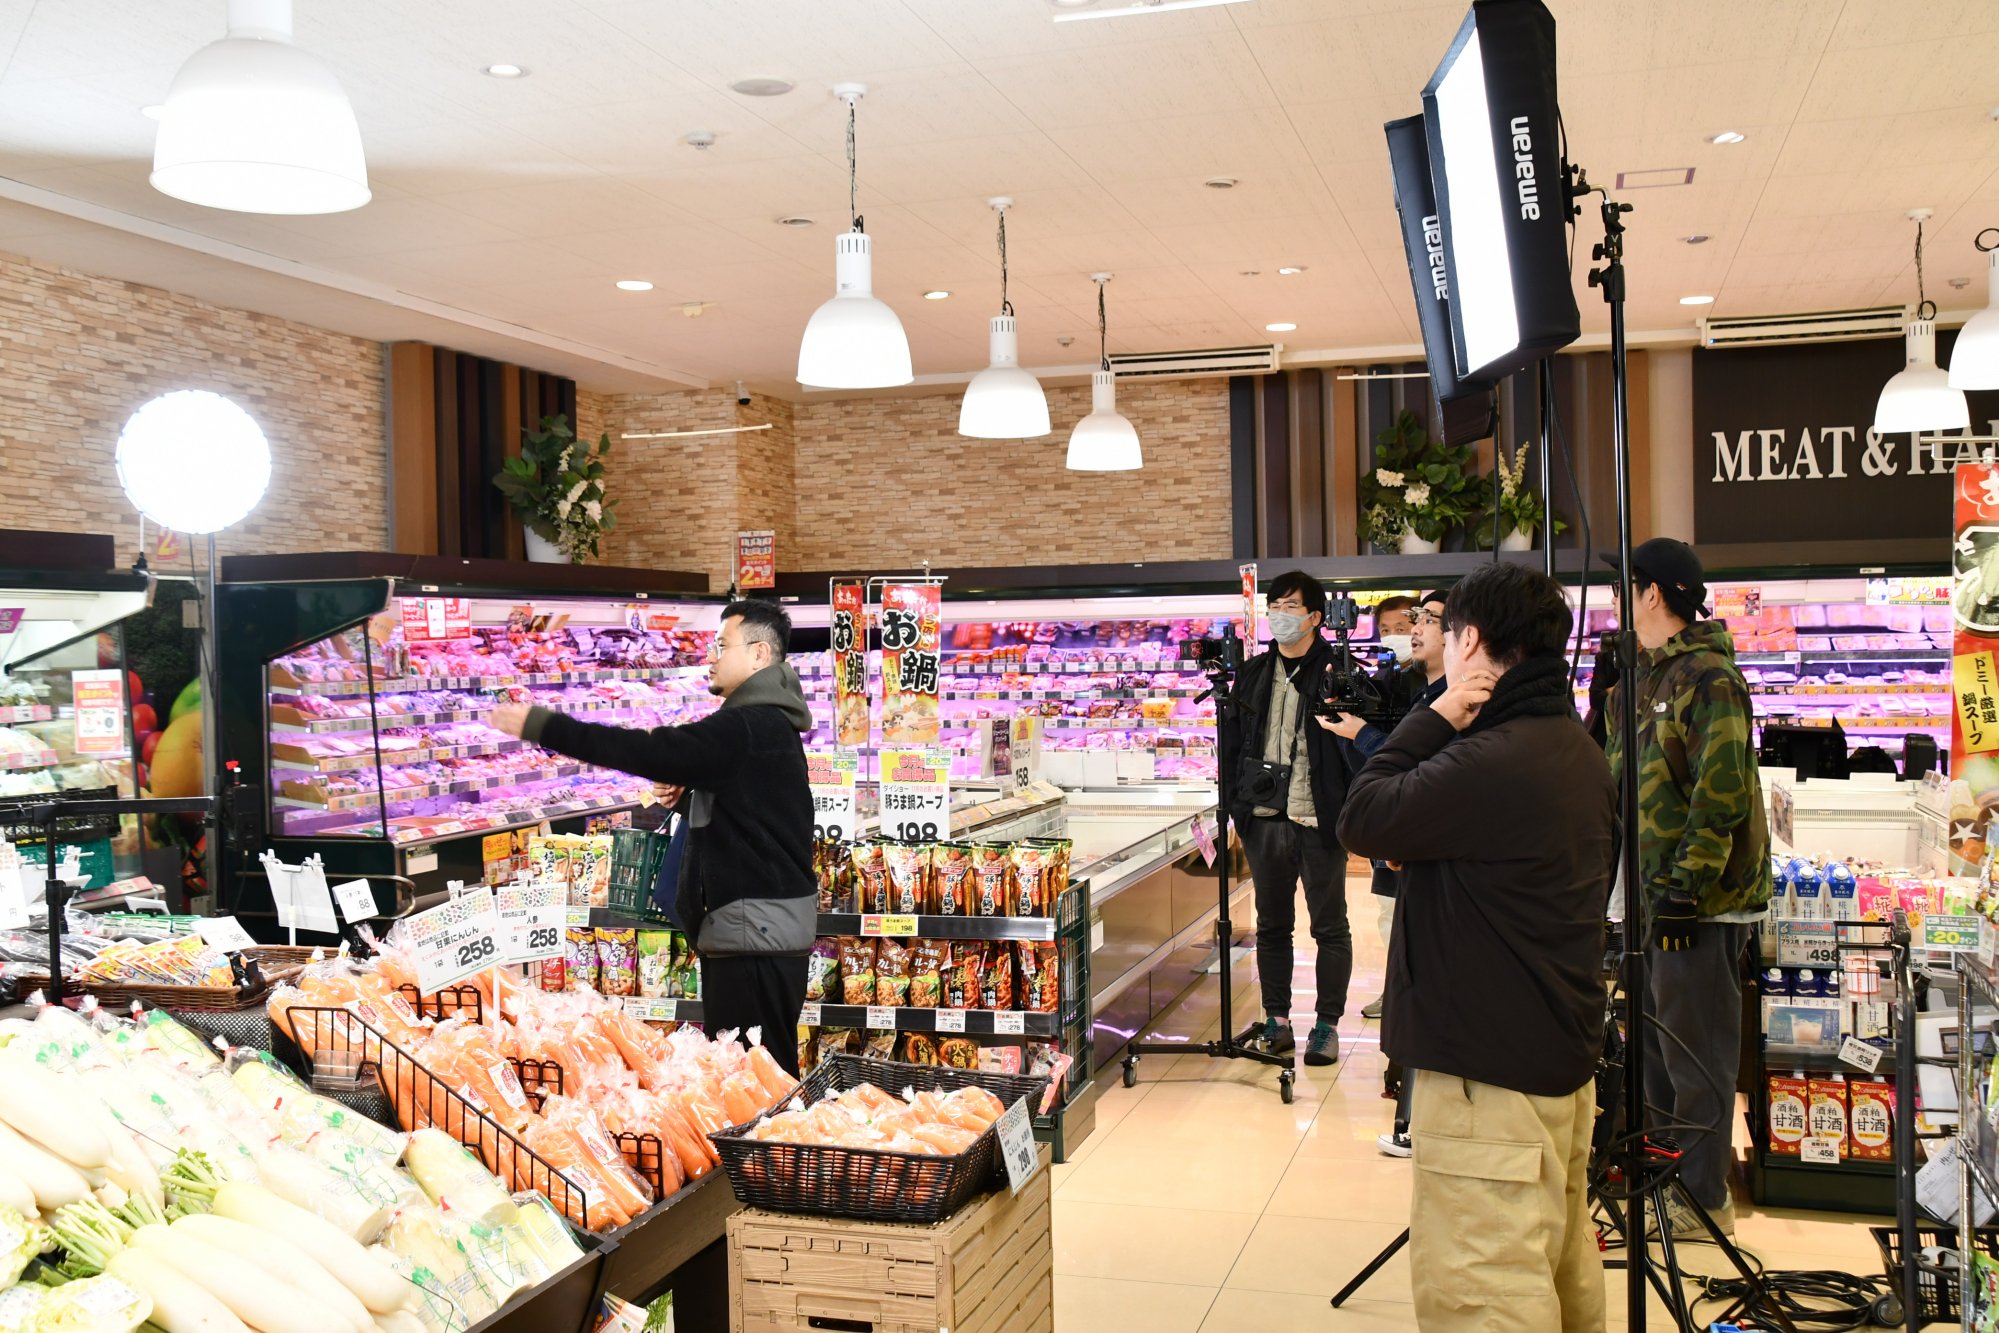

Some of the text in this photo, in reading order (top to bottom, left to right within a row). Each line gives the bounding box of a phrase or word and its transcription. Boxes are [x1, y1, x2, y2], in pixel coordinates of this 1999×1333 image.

[1510, 116, 1541, 221] amaran
[1711, 419, 1999, 483] MEAT & HA
[834, 610, 865, 693] お鍋
[882, 609, 939, 693] お鍋
[1974, 656, 1998, 724] ドミー厳選
[1961, 691, 1983, 746] 鍋スープ
[1016, 767, 1029, 788] 158
[885, 794, 943, 810] 豚うま鍋スープ
[897, 822, 938, 841] 198
[981, 875, 994, 910] 豚うま鍋
[530, 927, 558, 948] 258
[458, 935, 495, 966] 258
[1810, 949, 1841, 962] 498
[1858, 1054, 1873, 1066] 538
[1777, 1103, 1798, 1113] 酒粕
[1816, 1106, 1838, 1116] 酒粕
[1858, 1107, 1880, 1117] 酒粕
[1773, 1113, 1803, 1129] 甘酒
[1811, 1116, 1843, 1132] 甘酒
[1854, 1118, 1886, 1133] 甘酒
[1819, 1149, 1835, 1157] 458
